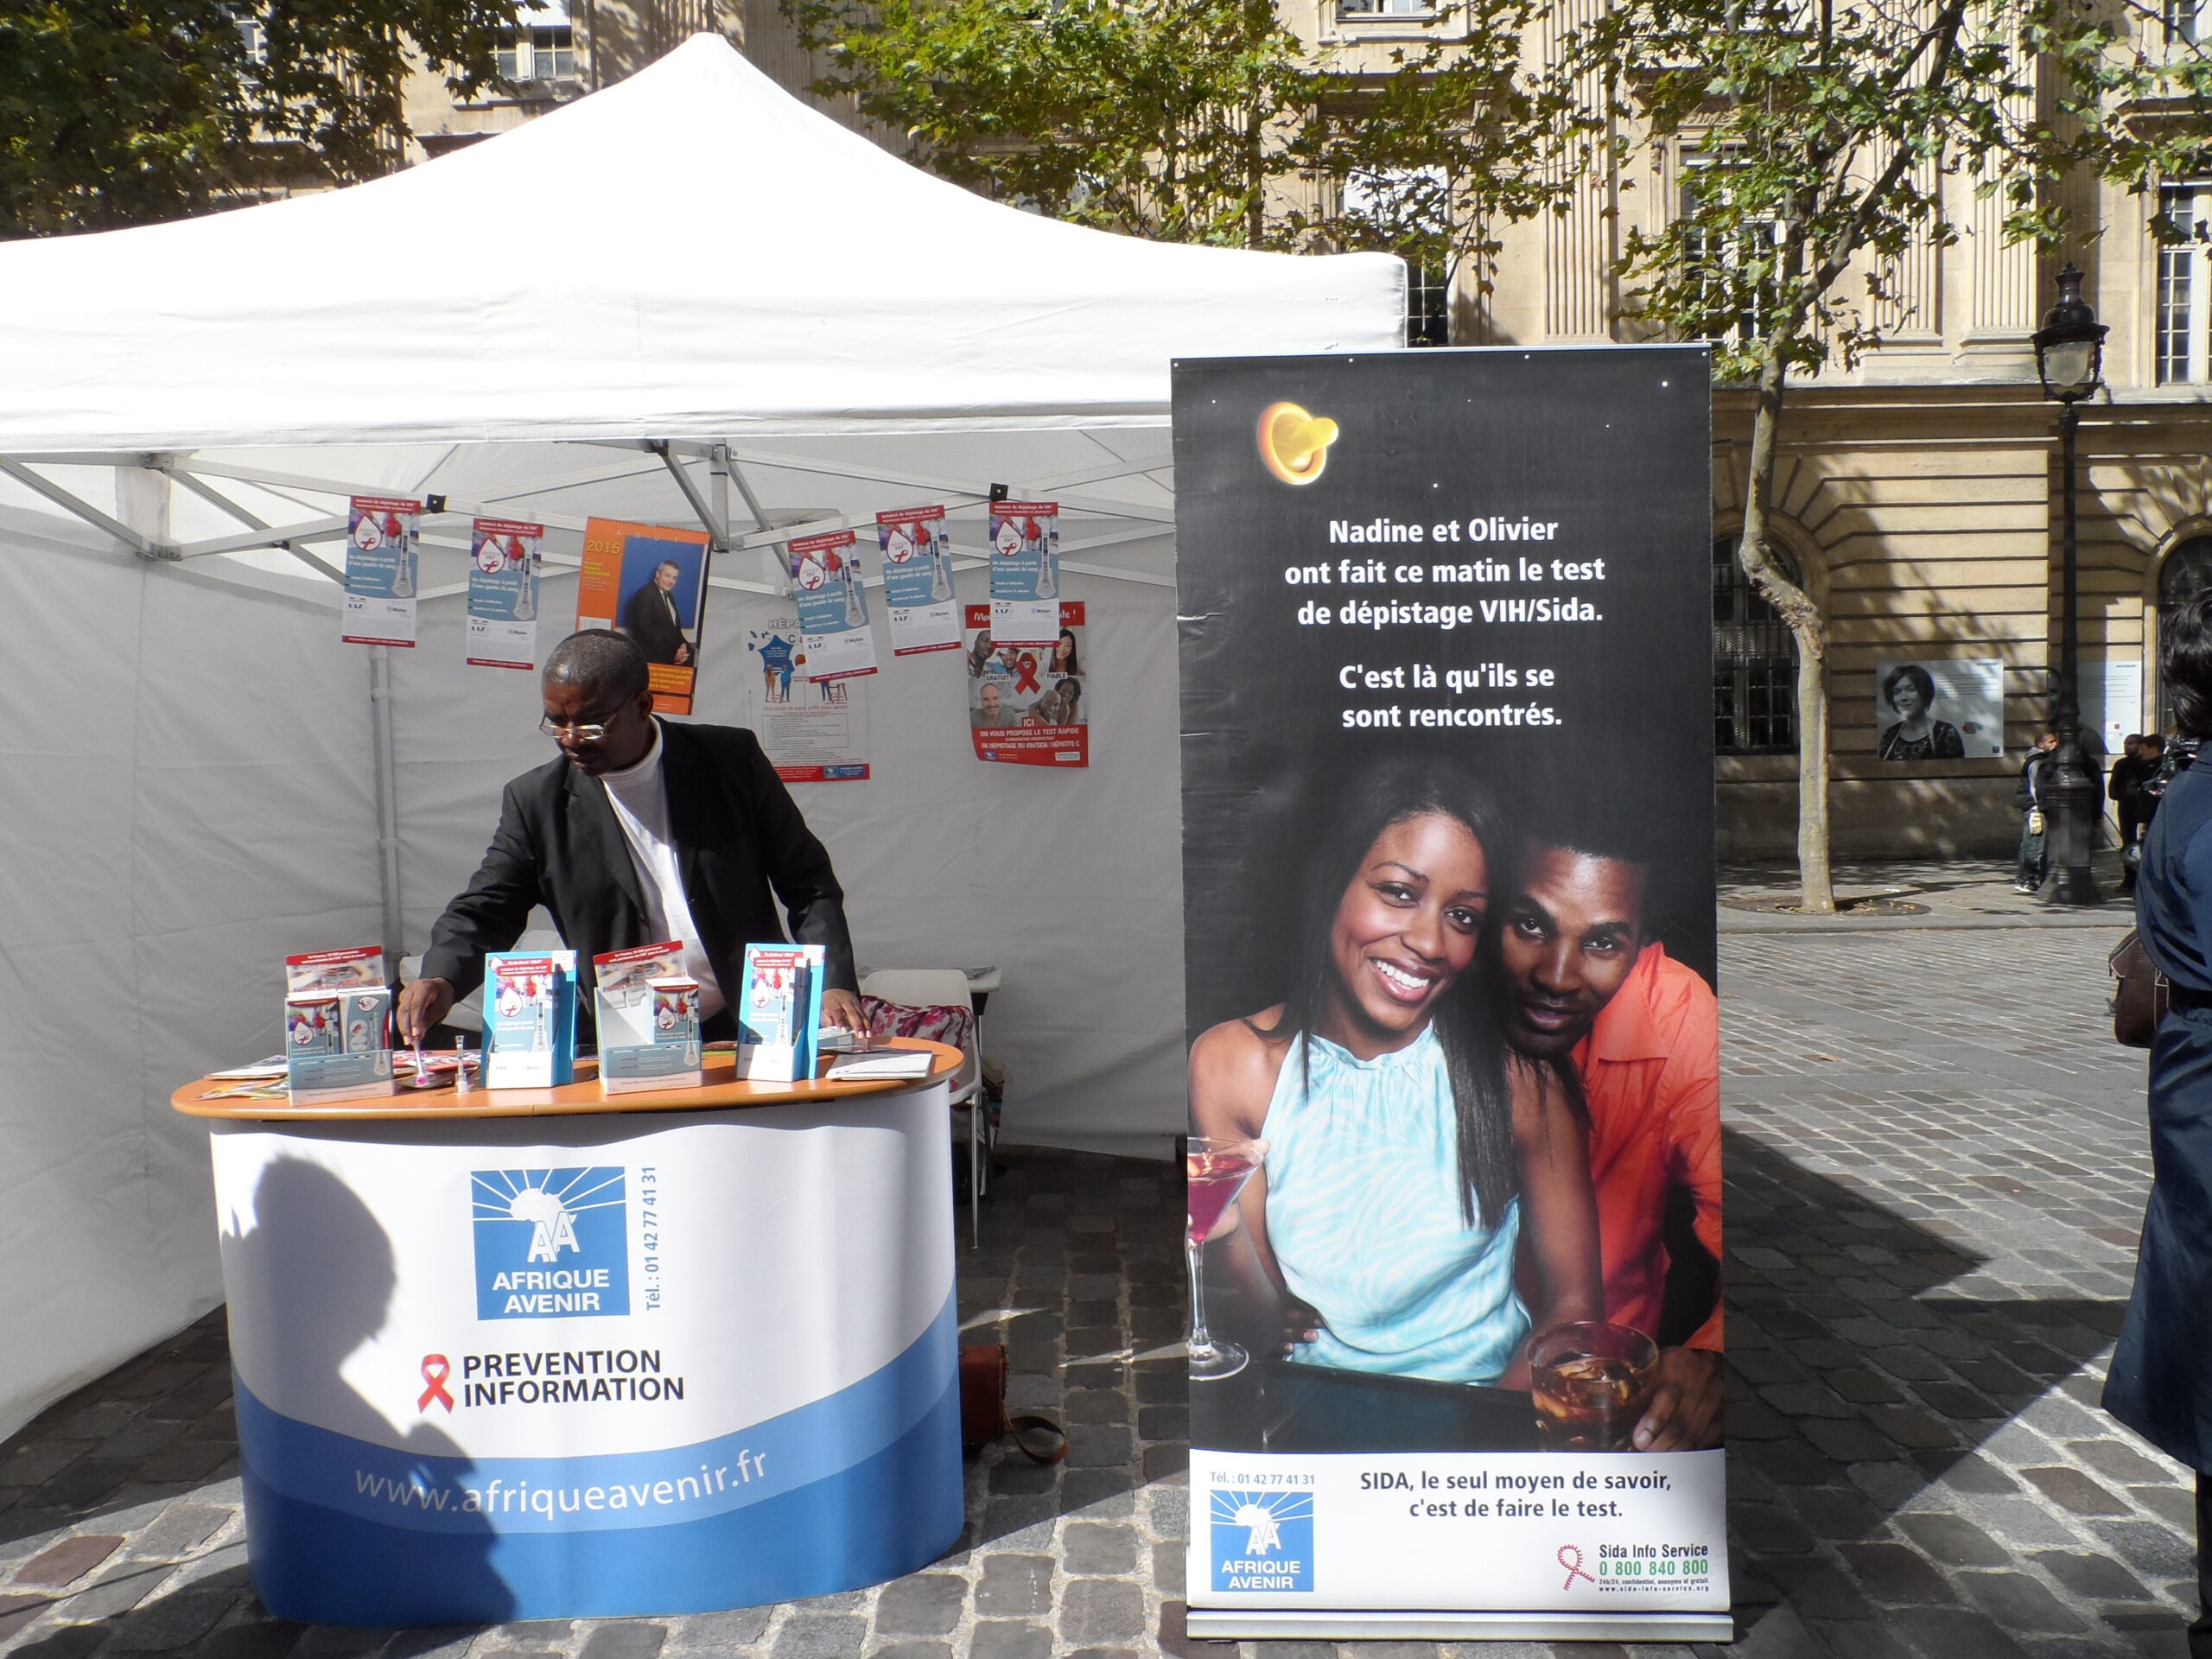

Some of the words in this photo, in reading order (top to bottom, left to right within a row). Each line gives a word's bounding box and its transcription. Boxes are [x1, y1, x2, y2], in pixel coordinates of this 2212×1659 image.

[1329, 518, 1423, 543] Nadine
[1433, 520, 1460, 543] et
[1469, 517, 1558, 542] Olivier
[588, 541, 620, 553] 2015
[1285, 563, 1331, 584] ont
[1338, 560, 1386, 583] fait
[1395, 563, 1424, 583] ce
[1433, 558, 1510, 582] matin
[1519, 557, 1543, 581] le
[1550, 558, 1605, 581] test
[1298, 601, 1331, 625] de
[1339, 600, 1472, 630] dépistage
[1479, 597, 1603, 624] VIH/Sida.
[1339, 664, 1405, 690] C'est
[1414, 664, 1436, 688] là
[1446, 664, 1517, 694] qu'ils
[1526, 668, 1554, 687] se
[1343, 705, 1402, 728] sont
[1410, 702, 1562, 727] rencontrés.
[641, 1166, 655, 1183] 31
[643, 1189, 657, 1206] 41
[643, 1211, 657, 1228] 77
[644, 1232, 658, 1251] 42
[645, 1256, 658, 1272] 01
[493, 1269, 610, 1291] AFRIQUE
[504, 1293, 600, 1313] AVENIR
[463, 1350, 662, 1379] PREVENTION
[465, 1377, 684, 1408] INFORMATION
[355, 1449, 766, 1521] www.afriqueavenir.fr
[1237, 1474, 1249, 1484] 01
[1253, 1474, 1267, 1484] 42
[1270, 1474, 1283, 1484] 77
[1286, 1474, 1298, 1484] 41
[1303, 1474, 1314, 1484] 31
[1360, 1472, 1414, 1493] SIDA,
[1422, 1471, 1440, 1491] le
[1446, 1471, 1488, 1490] seul
[1495, 1474, 1564, 1495] moyen
[1573, 1471, 1597, 1490] de
[1605, 1471, 1672, 1493] savoir,
[1409, 1499, 1457, 1518] c'est
[1464, 1499, 1488, 1517] de
[1496, 1499, 1544, 1517] faire
[1552, 1499, 1569, 1517] le
[1577, 1501, 1623, 1518] test.
[1599, 1544, 1627, 1558] Sida
[1633, 1544, 1656, 1558] Info
[1662, 1543, 1708, 1558] Service
[1221, 1560, 1301, 1574] AFRIQUE
[1599, 1560, 1607, 1576] 0
[1616, 1560, 1642, 1576] 800
[1649, 1560, 1675, 1575] 840
[1682, 1559, 1708, 1574] 800
[1229, 1576, 1294, 1588] AVENIR
